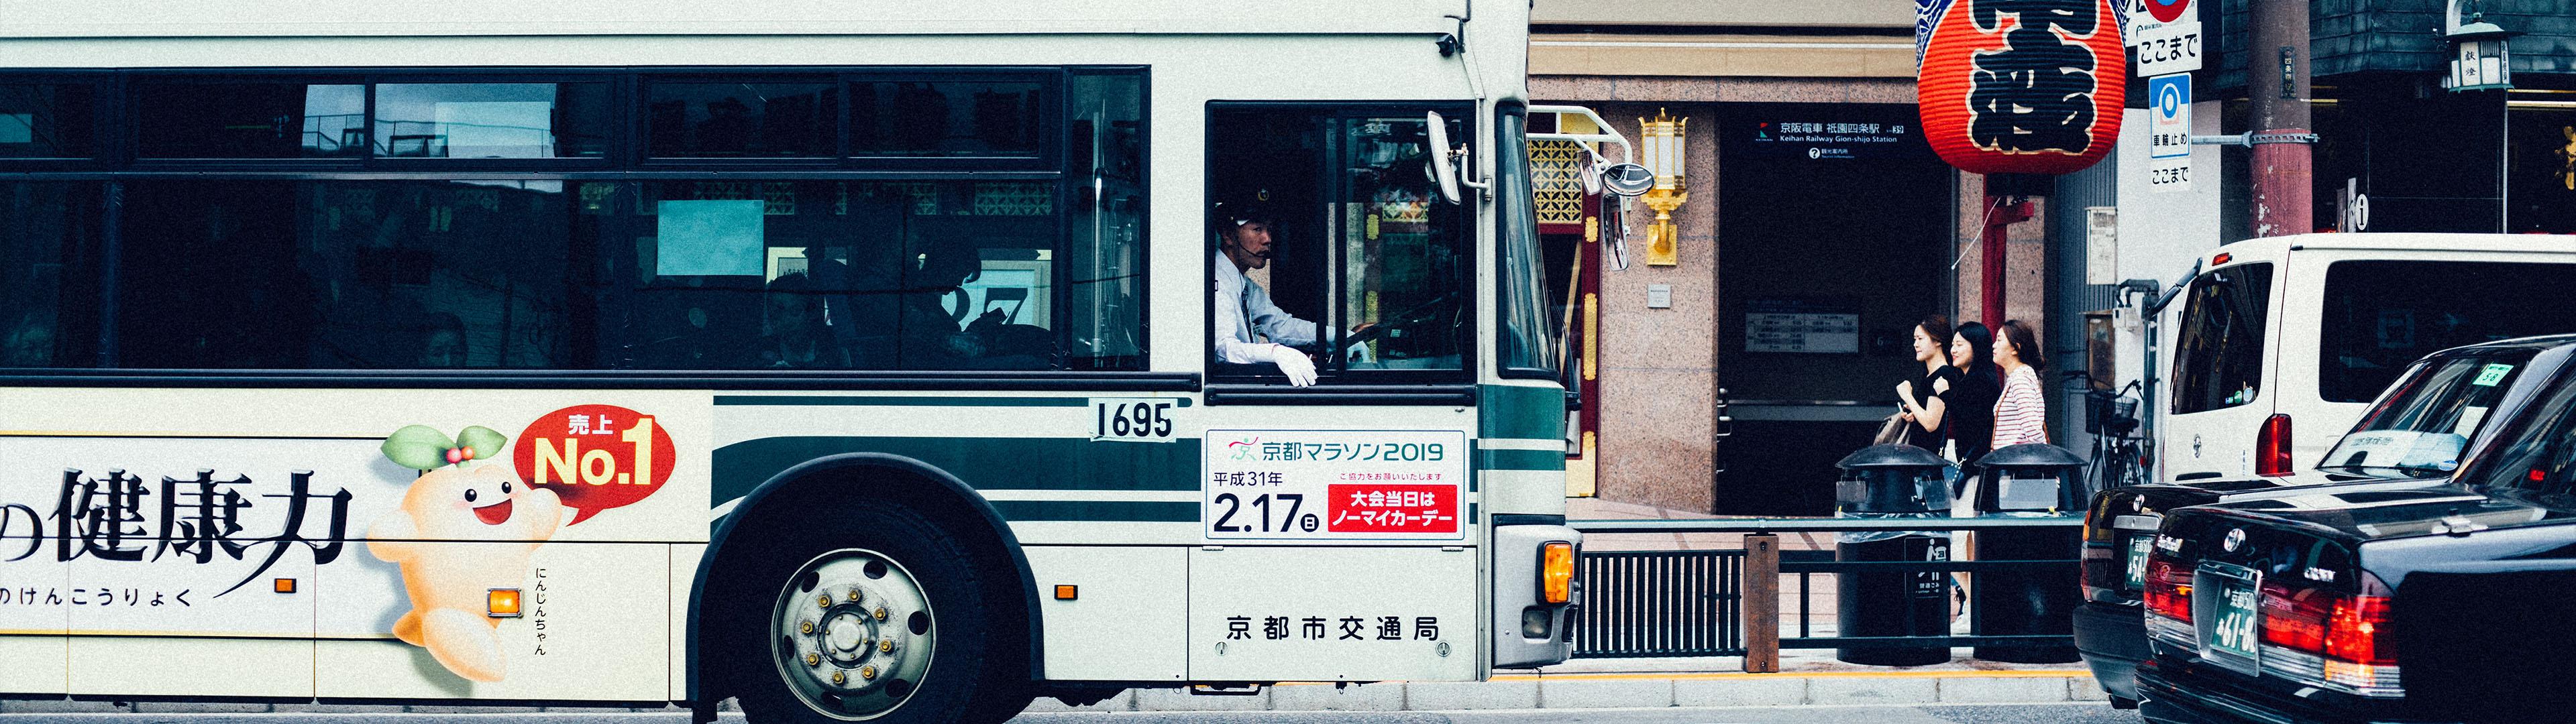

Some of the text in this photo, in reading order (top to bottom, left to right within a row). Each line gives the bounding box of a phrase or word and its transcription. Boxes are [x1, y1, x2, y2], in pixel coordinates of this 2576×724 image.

[2141, 34, 2198, 64] ここまで
[1780, 123, 1823, 133] 京阪電車
[2153, 132, 2188, 146] 車輪止め
[2153, 166, 2188, 184] ここまで
[568, 414, 614, 435] 売上
[1095, 402, 1172, 438] 1695
[535, 418, 653, 485] No.1
[1262, 442, 1444, 462] 京都マラソン2019
[1214, 471, 1283, 487] 平成31年
[1350, 490, 1435, 507] 大会当日は
[1332, 509, 1452, 527] ノーマイカーデー
[0, 467, 353, 599] の健康力
[0, 587, 191, 607] のけんこうりょく
[535, 568, 547, 656] にんじんちゃん
[1226, 615, 1439, 641] 京都市交通局
